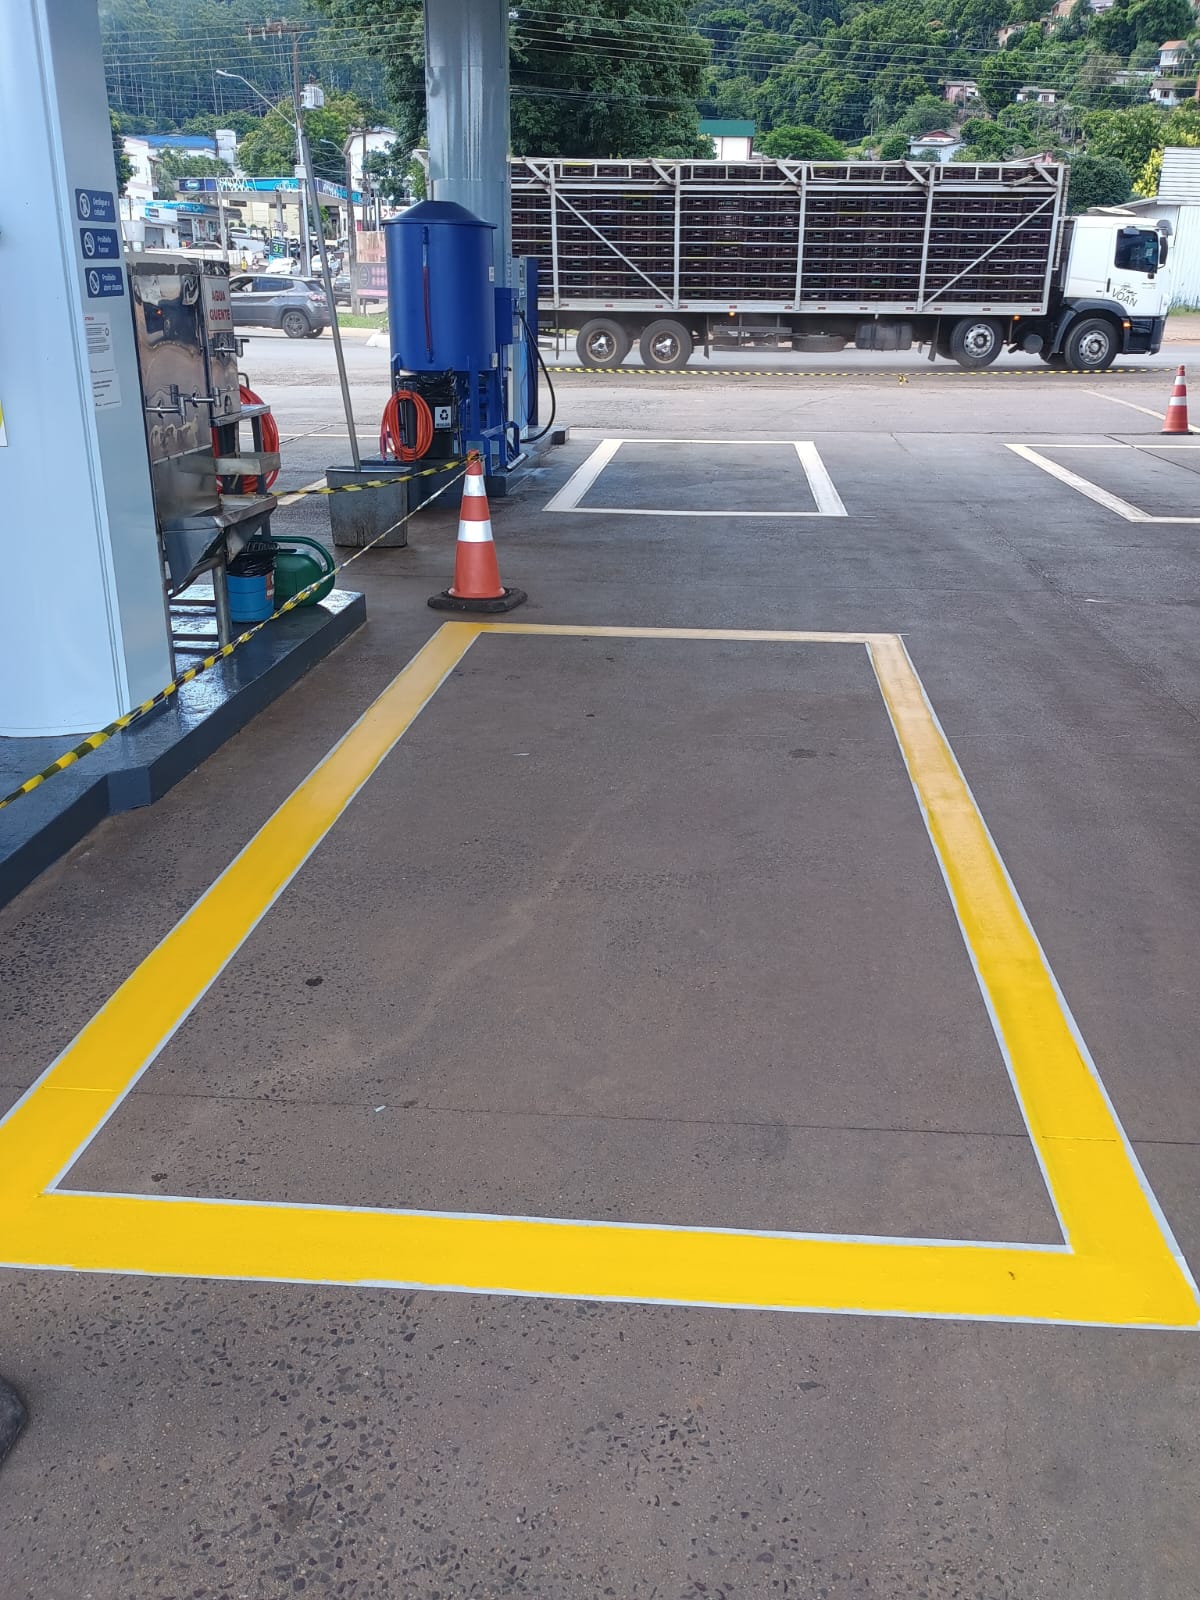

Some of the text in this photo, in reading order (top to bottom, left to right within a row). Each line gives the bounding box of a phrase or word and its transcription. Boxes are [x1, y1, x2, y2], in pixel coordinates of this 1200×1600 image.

[97, 235, 112, 243] Proibido
[102, 273, 116, 281] Proibido
[212, 290, 225, 301] AGUA
[210, 309, 230, 320] QUENTE
